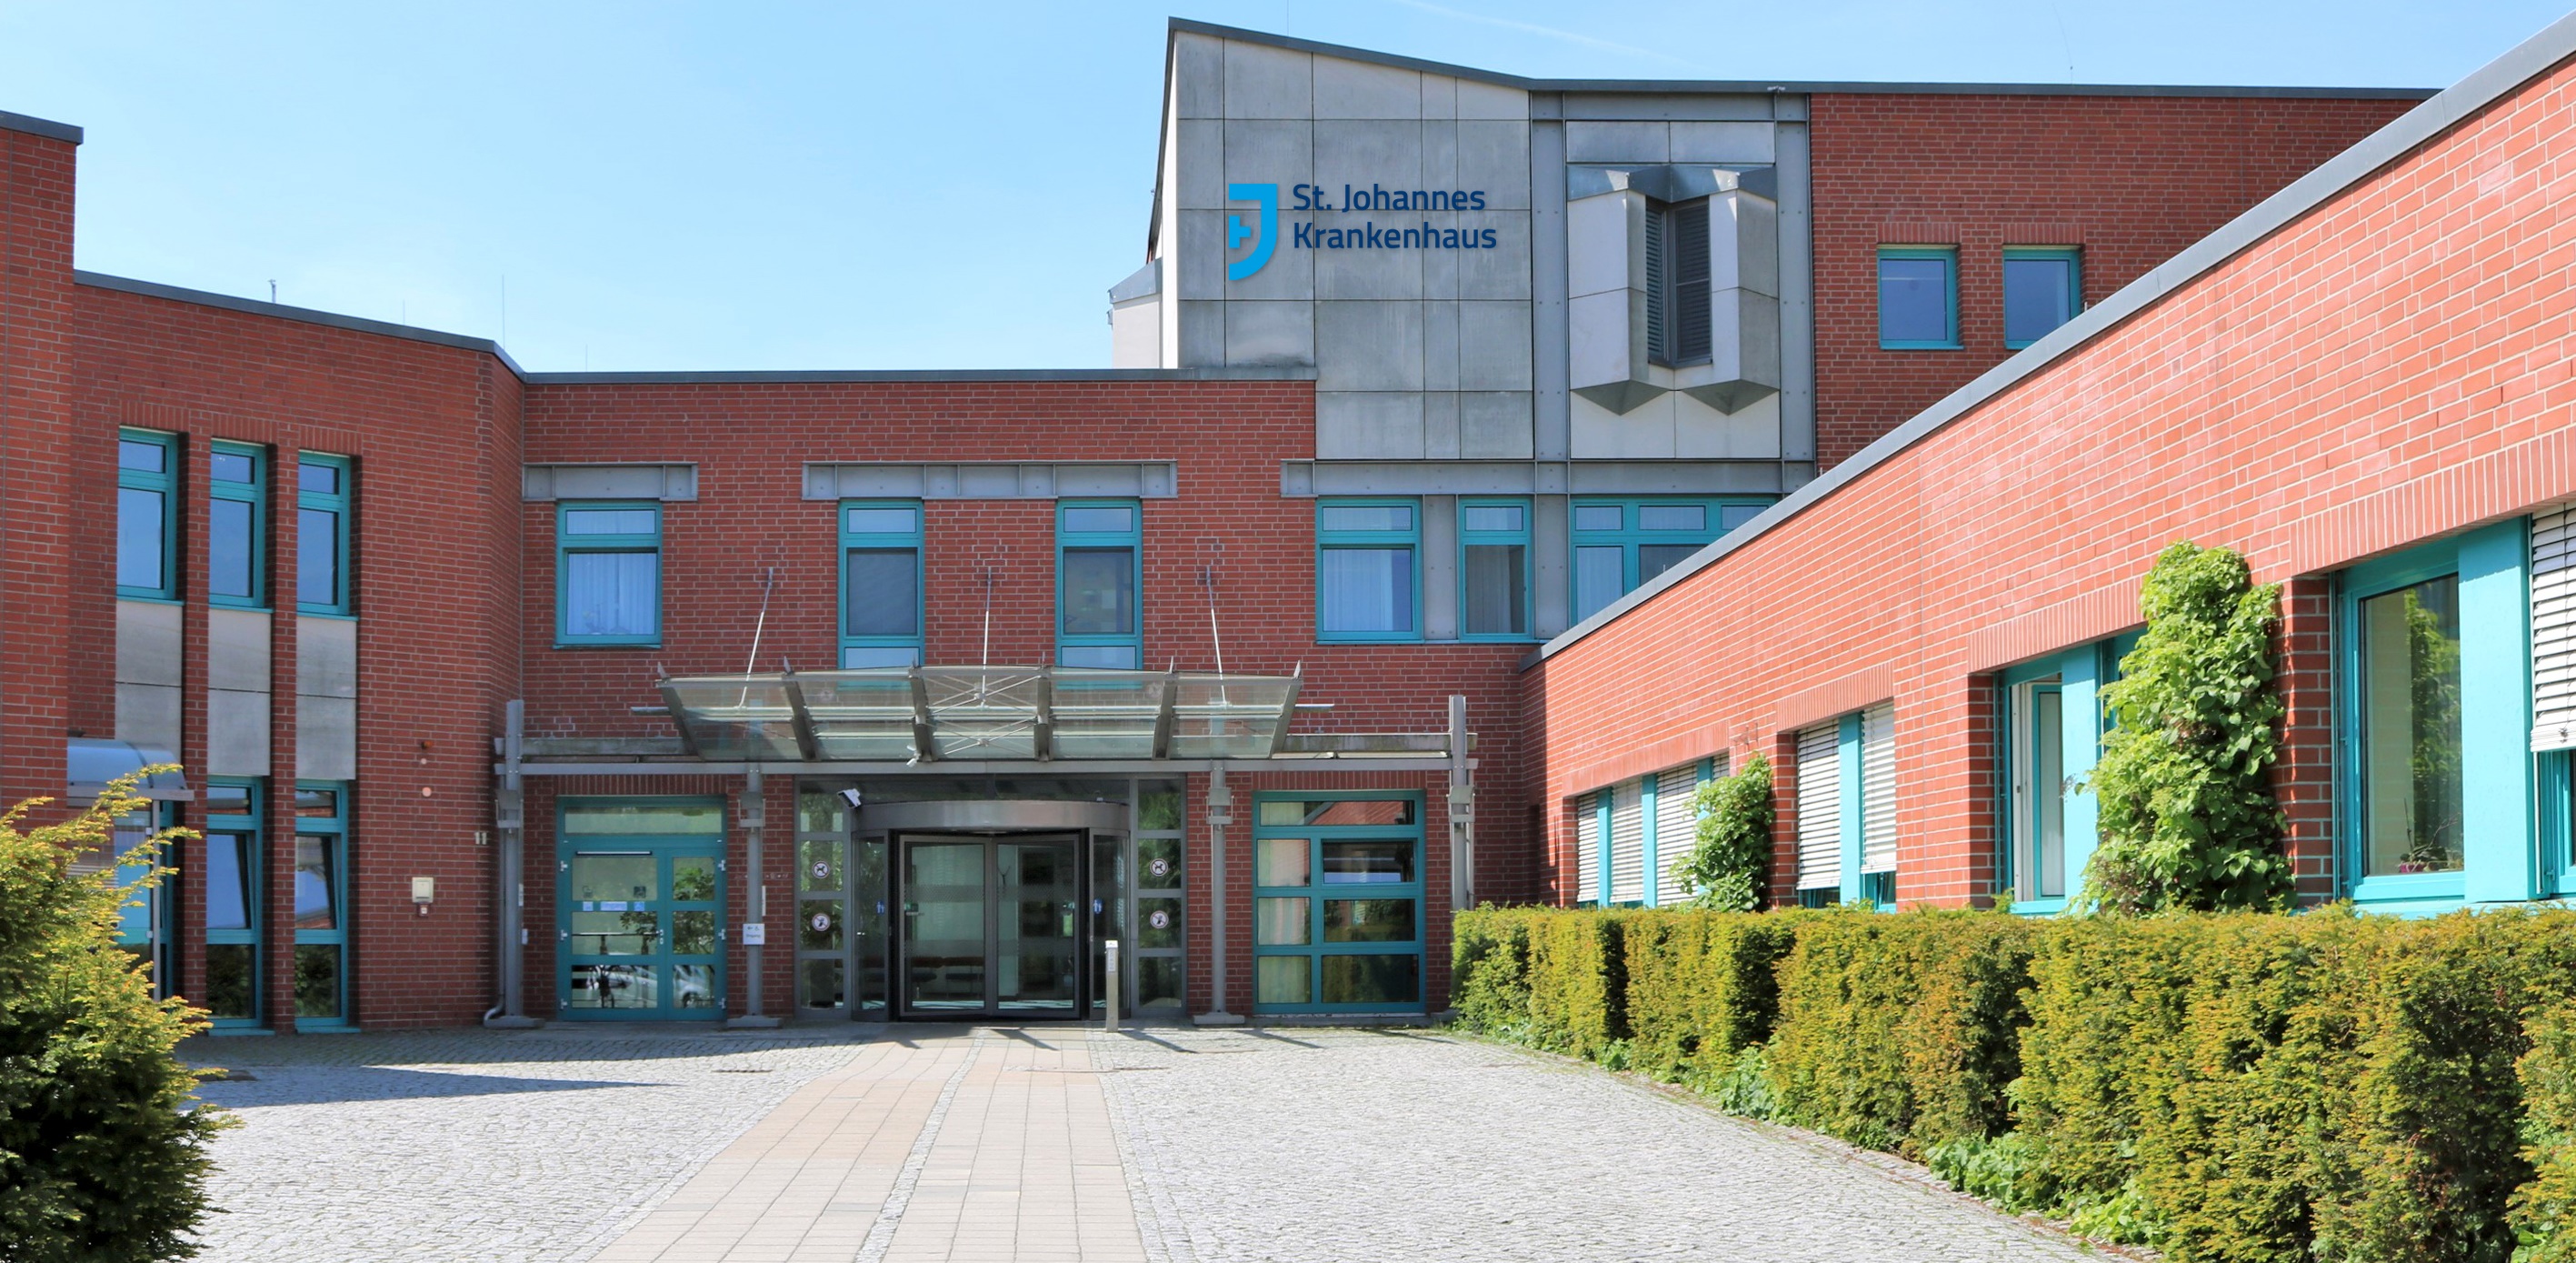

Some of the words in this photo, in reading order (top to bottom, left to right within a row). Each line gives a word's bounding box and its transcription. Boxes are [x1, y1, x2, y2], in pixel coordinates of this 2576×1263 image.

[1293, 184, 1333, 211] St.
[1342, 183, 1486, 213] Johannes
[1293, 221, 1497, 249] Krankenhaus
